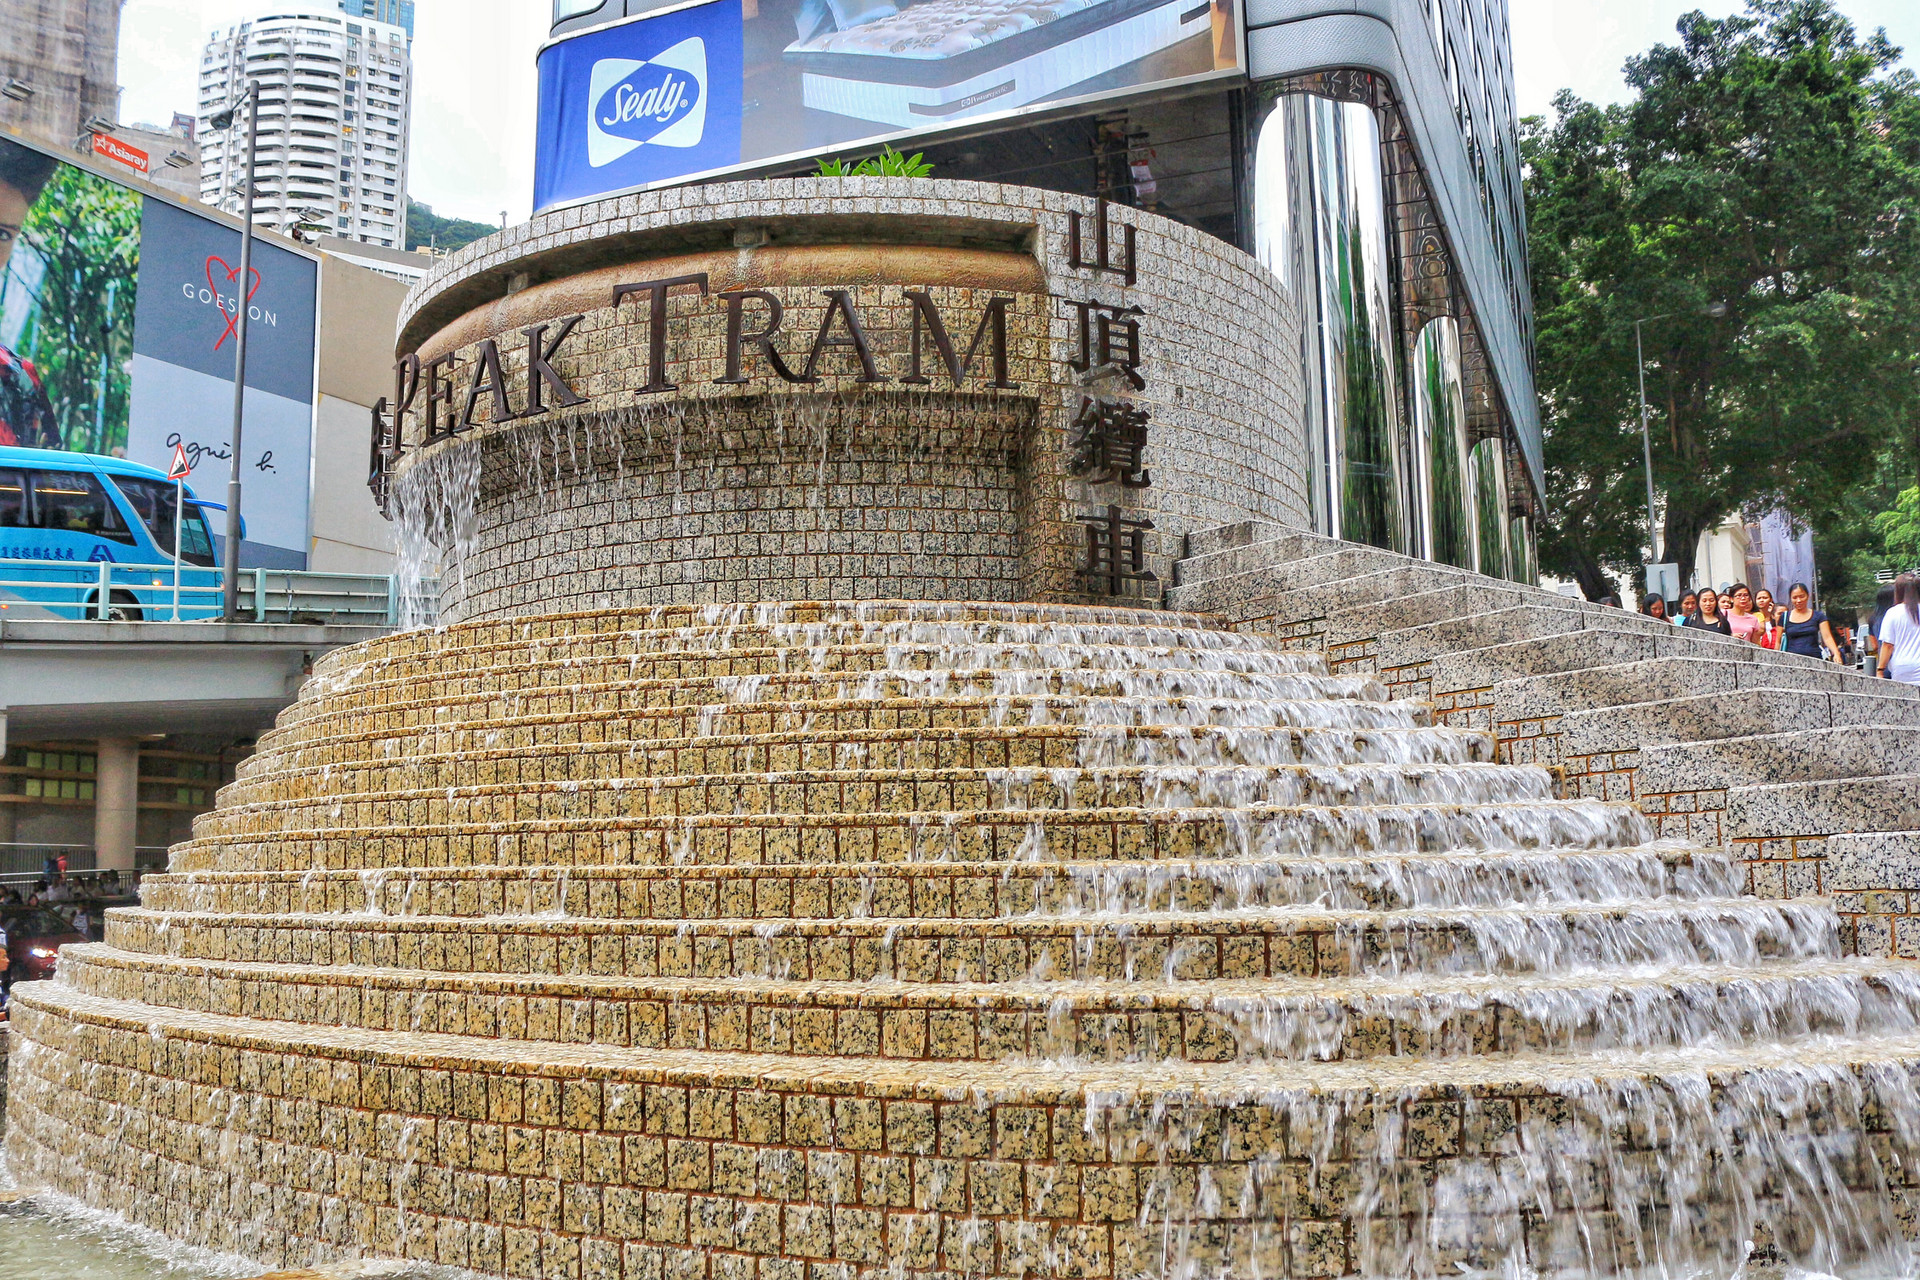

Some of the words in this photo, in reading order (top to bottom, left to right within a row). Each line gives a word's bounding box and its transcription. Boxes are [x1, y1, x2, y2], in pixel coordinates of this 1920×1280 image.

[603, 73, 686, 126] Sealy
[108, 143, 147, 169] Asiaray
[182, 283, 237, 313] GOES
[248, 305, 277, 327] ON
[387, 314, 588, 464] PEAK
[612, 272, 1020, 395] TRAM
[1064, 193, 1158, 597] 山頂纜車
[166, 432, 236, 470] agnè
